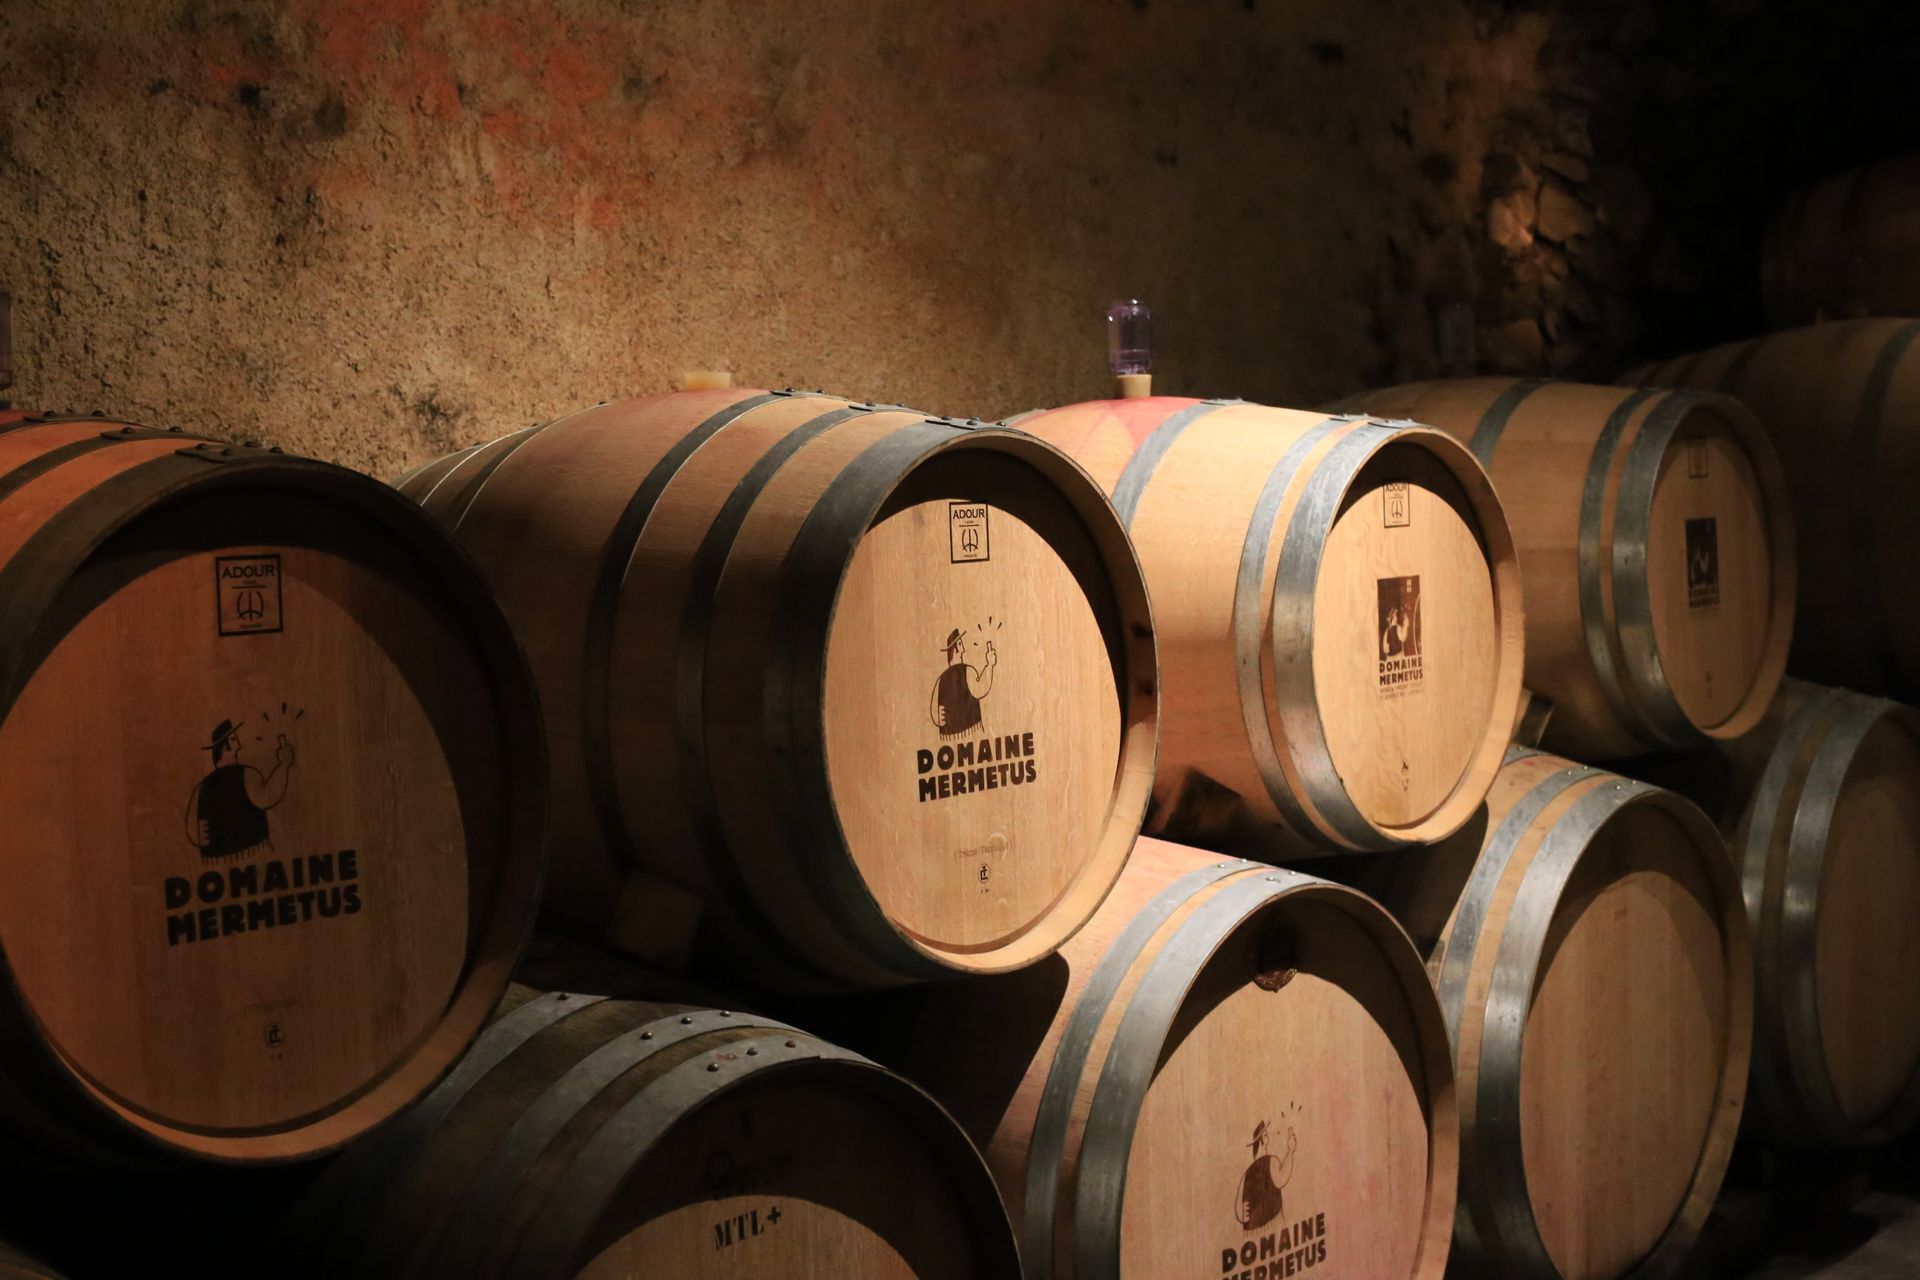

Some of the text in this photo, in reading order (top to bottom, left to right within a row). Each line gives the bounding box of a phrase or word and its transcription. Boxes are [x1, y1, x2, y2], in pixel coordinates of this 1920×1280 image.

[953, 508, 985, 519] ADOUR
[222, 564, 275, 579] ADOUR
[1379, 657, 1422, 674] DOMAINE
[1380, 669, 1423, 686] MERMETUS
[917, 732, 1035, 774] DOMAINE
[919, 759, 1037, 802] MERMETUS
[164, 849, 358, 909] DOMAINE
[167, 884, 361, 946] MERMETUS
[1222, 1212, 1325, 1274] DOMAINE
[1223, 1239, 1326, 1280] RMETUS
